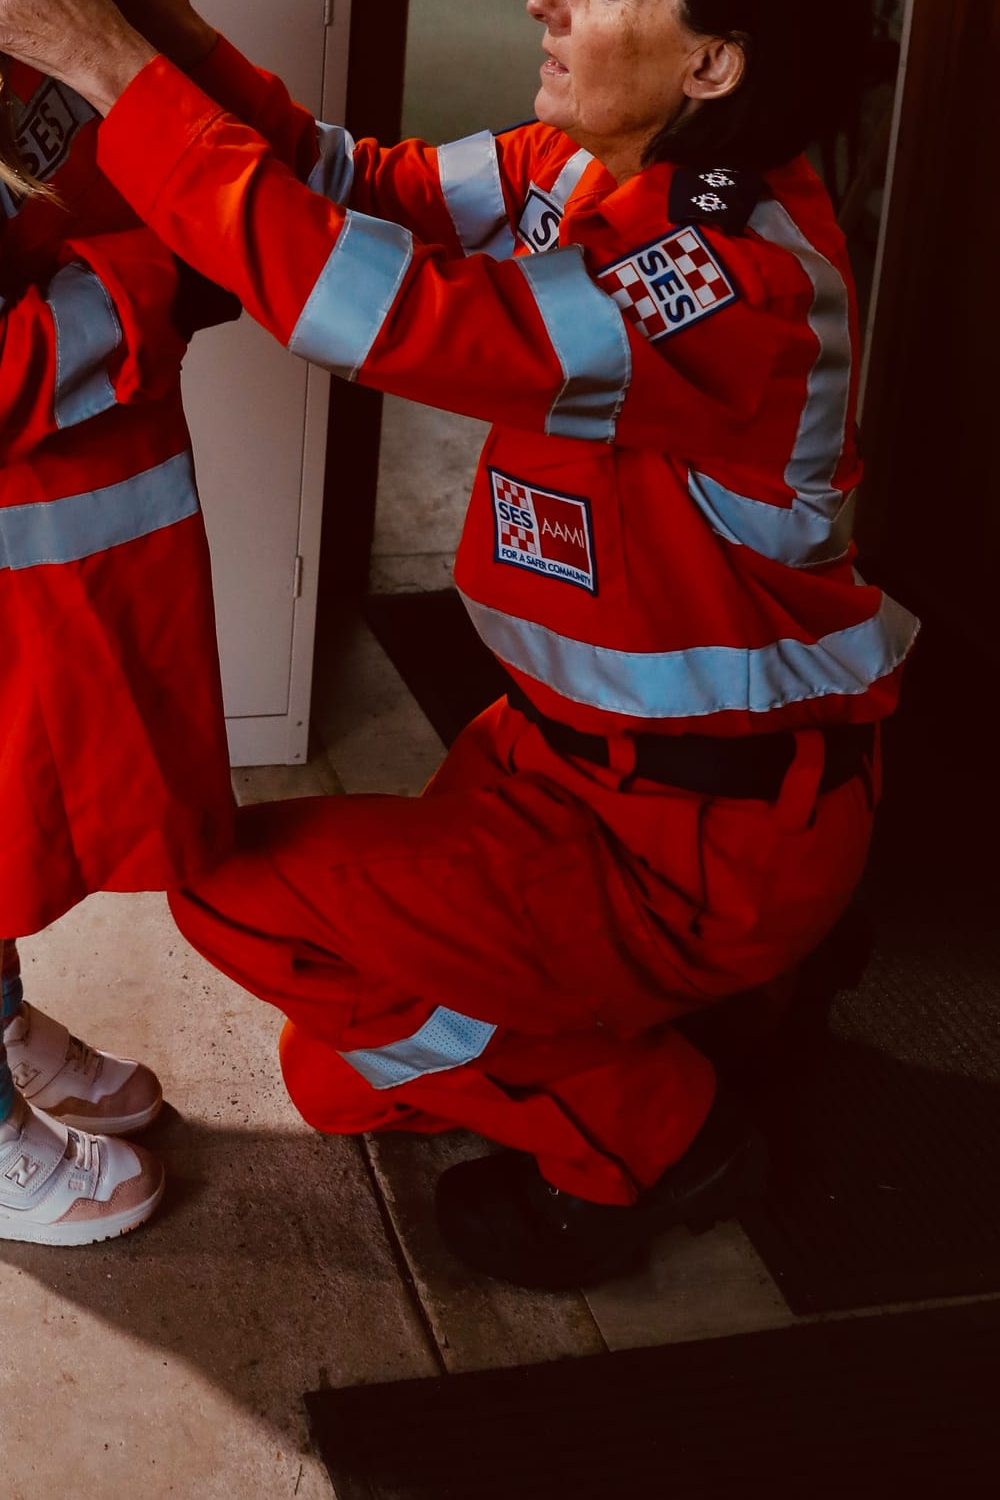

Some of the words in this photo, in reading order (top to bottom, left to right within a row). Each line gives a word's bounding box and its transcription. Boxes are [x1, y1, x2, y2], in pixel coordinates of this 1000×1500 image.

[637, 250, 696, 324] SES
[498, 501, 534, 530] SES
[541, 517, 585, 549] AAMI
[502, 547, 518, 559] FOR
[519, 553, 526, 563] A
[526, 555, 548, 571] SAFER
[547, 562, 592, 586] COMMUNITY
